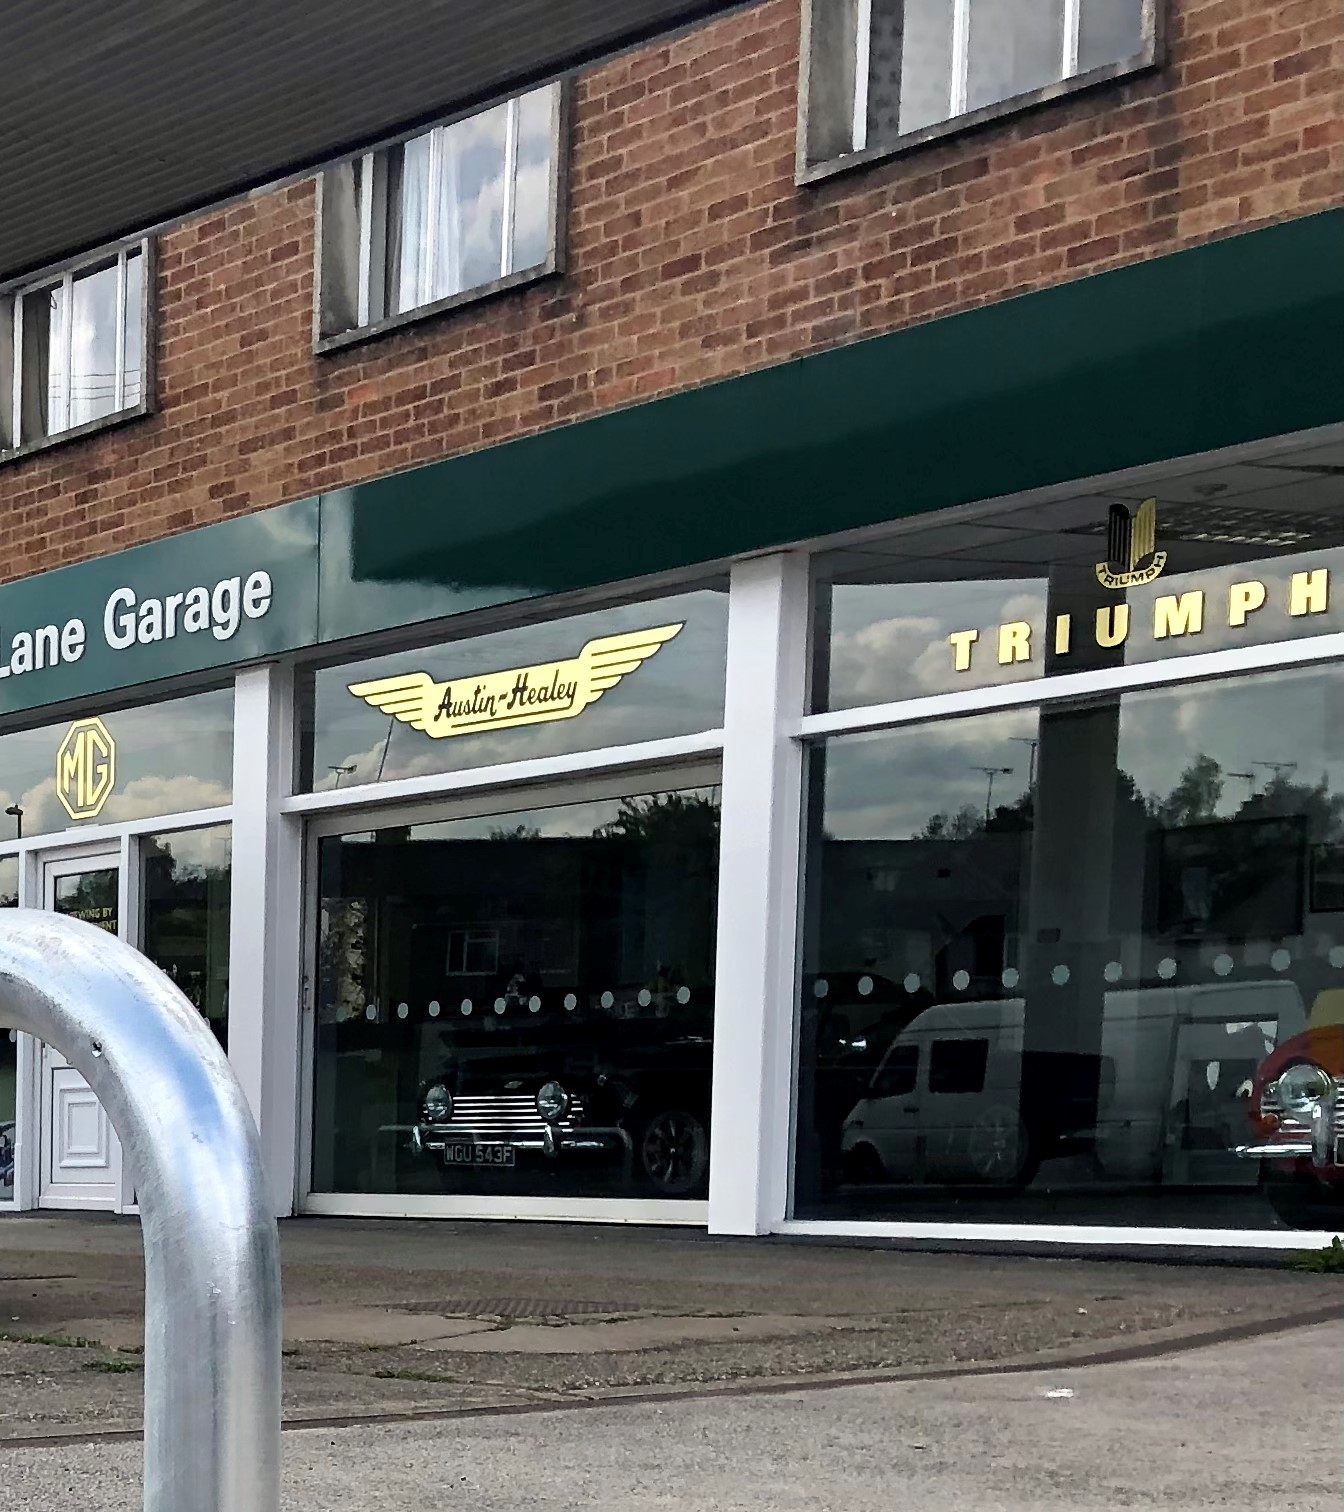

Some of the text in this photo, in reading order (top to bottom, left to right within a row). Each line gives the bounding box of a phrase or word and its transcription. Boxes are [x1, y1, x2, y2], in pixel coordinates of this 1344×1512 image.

[1099, 554, 1164, 585] TRIUMPH
[104, 570, 273, 650] Garage
[949, 568, 1329, 671] TRIUMPH
[434, 669, 578, 724] Austin-Healey
[62, 728, 109, 808] MG
[103, 907, 113, 918] BY
[446, 1145, 512, 1163] WGU 543F
